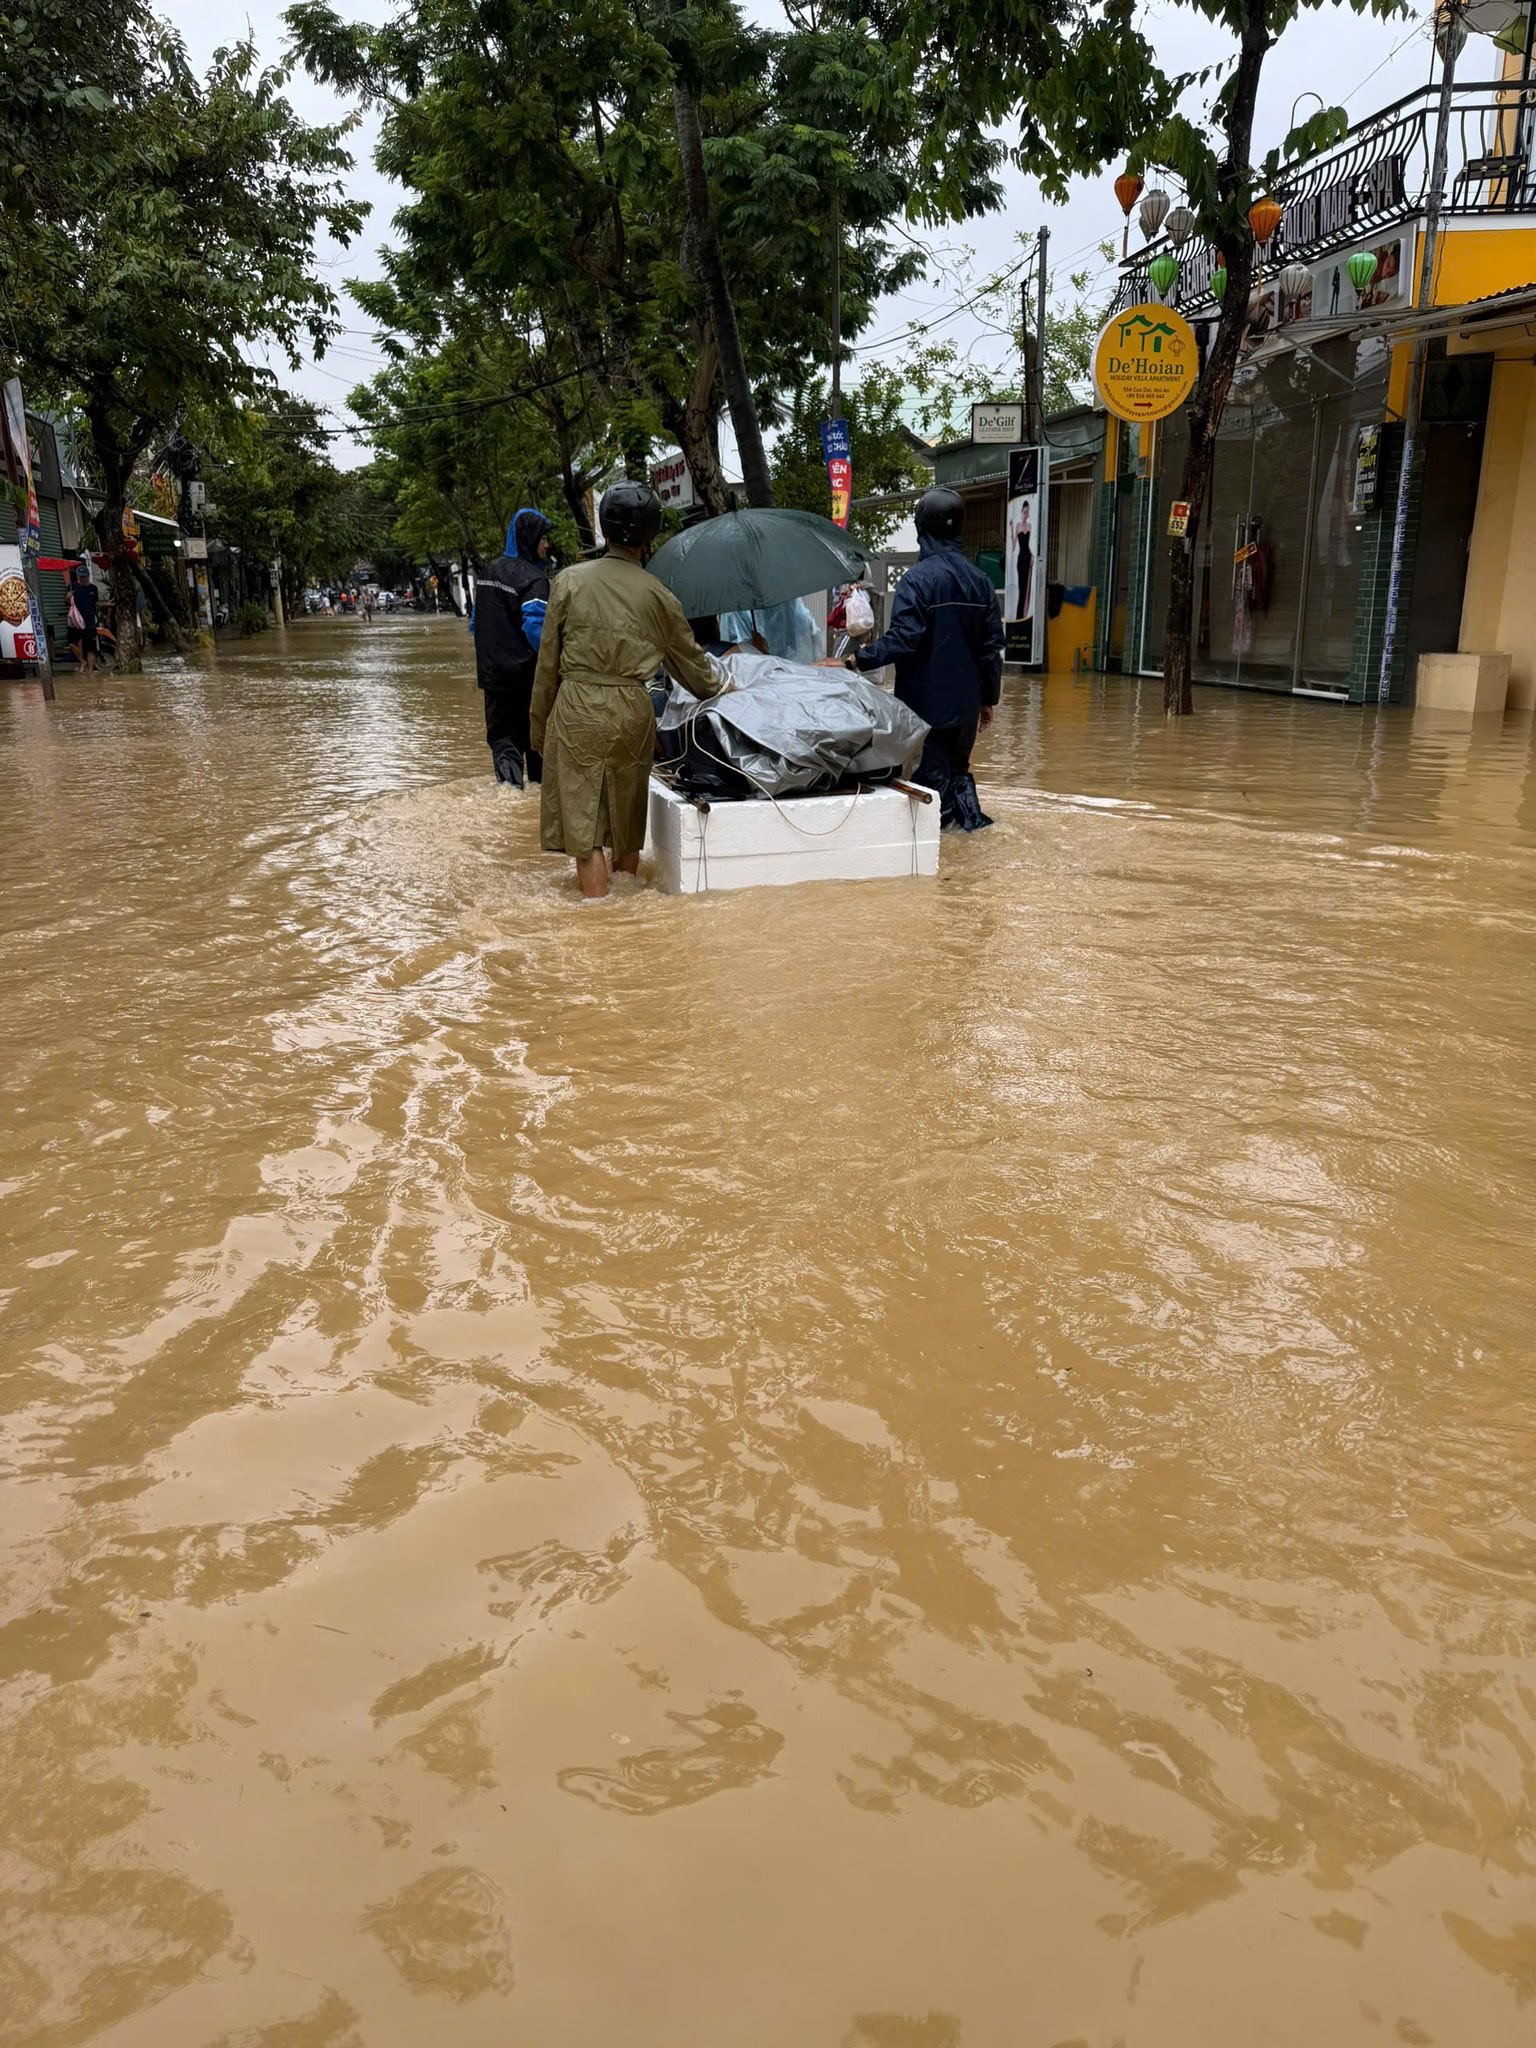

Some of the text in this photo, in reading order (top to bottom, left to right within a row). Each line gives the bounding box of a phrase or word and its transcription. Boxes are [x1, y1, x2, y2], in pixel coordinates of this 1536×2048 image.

[1182, 249, 1217, 300] LEATHER
[1320, 177, 1353, 237] MADE
[1368, 157, 1393, 214] SPA
[1108, 357, 1184, 375] De'Hoian
[1171, 520, 1184, 530] 552
